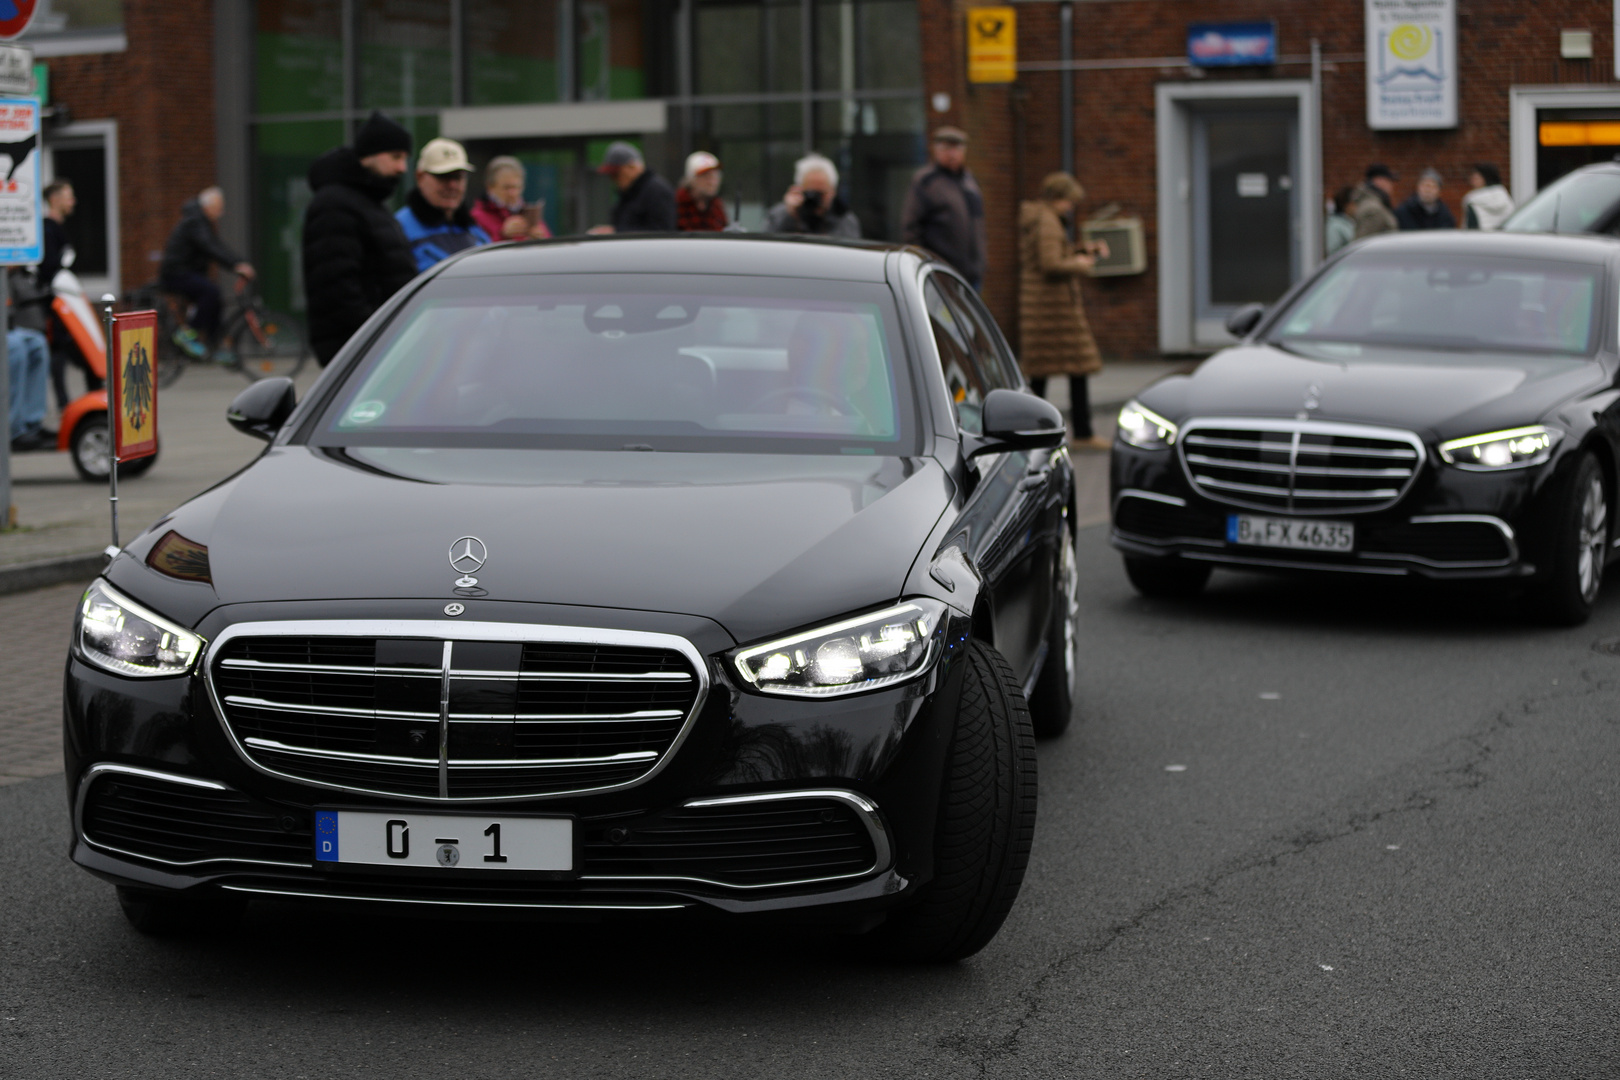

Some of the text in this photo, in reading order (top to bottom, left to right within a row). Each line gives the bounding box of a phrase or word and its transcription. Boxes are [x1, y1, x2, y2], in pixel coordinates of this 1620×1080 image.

[1239, 519, 1350, 547] B FX 4635
[322, 840, 332, 853] D
[483, 822, 508, 863] 1
